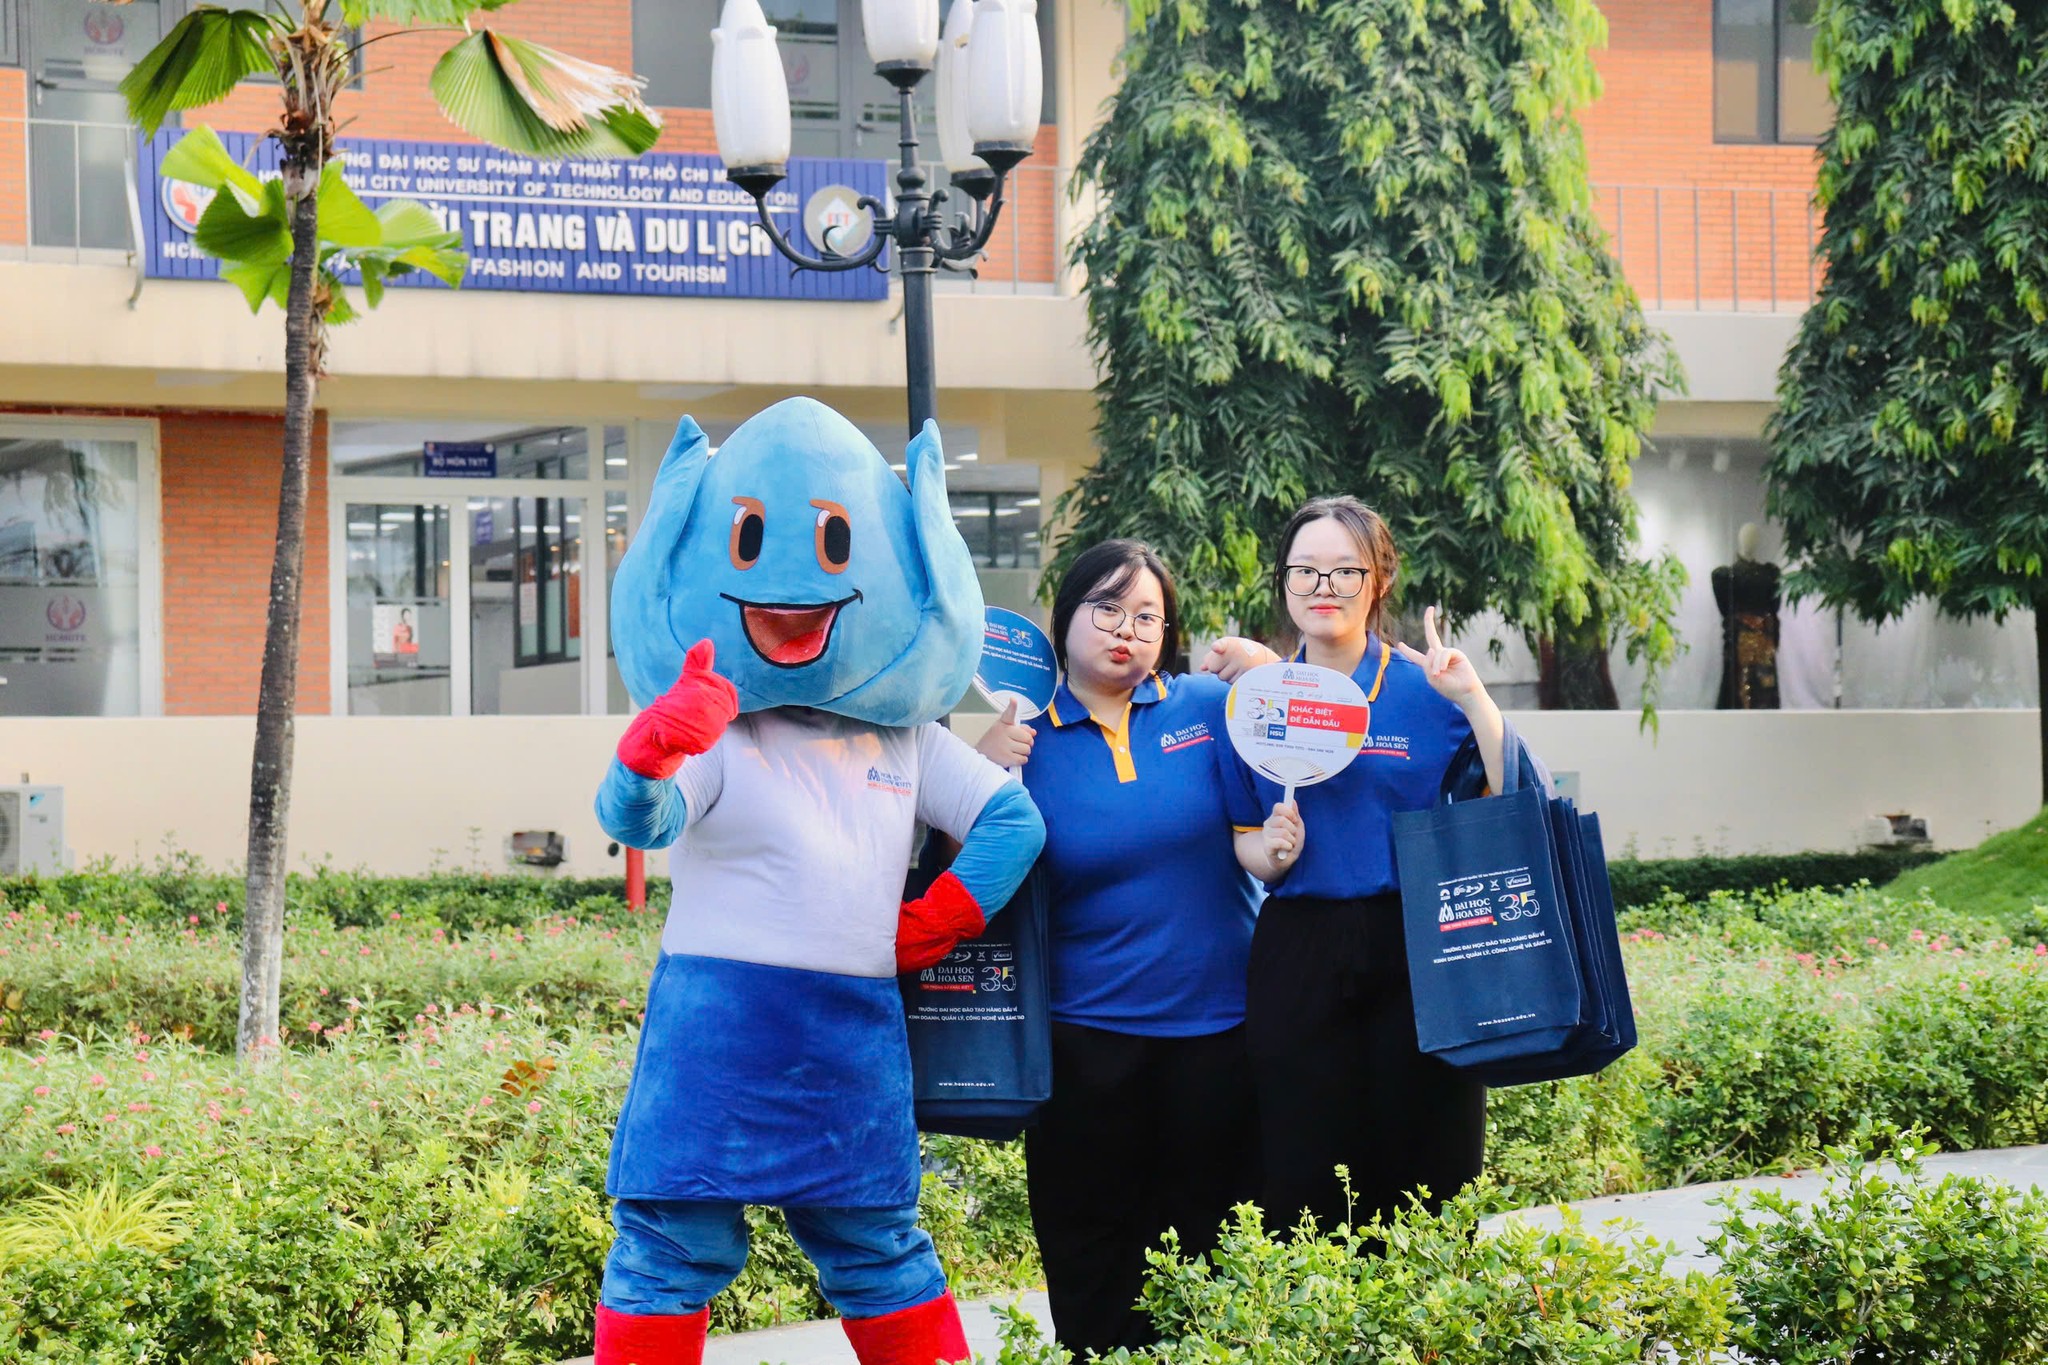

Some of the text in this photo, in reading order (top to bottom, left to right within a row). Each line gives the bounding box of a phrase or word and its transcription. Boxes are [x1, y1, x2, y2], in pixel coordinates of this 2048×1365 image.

[414, 155, 450, 173] HỌC
[569, 162, 621, 180] THUẬT
[371, 175, 411, 191] CITY
[416, 177, 517, 195] UNIVERSITY
[523, 182, 547, 197] OF
[552, 183, 664, 202] TECHNOLOGY
[669, 188, 704, 203] AND
[469, 211, 586, 251] TRANG
[595, 209, 637, 252] VÀ
[645, 217, 689, 253] DU
[697, 219, 773, 262] LỊCH
[470, 258, 727, 283] FASHION AND TOURISM
[1291, 704, 1333, 717] KHÁC BIỆT
[1177, 728, 1209, 743] HOA SEN
[1455, 906, 1492, 920] HOA SEN
[1498, 889, 1540, 922] 35
[958, 974, 974, 982] SEN
[980, 966, 1017, 991] 35
